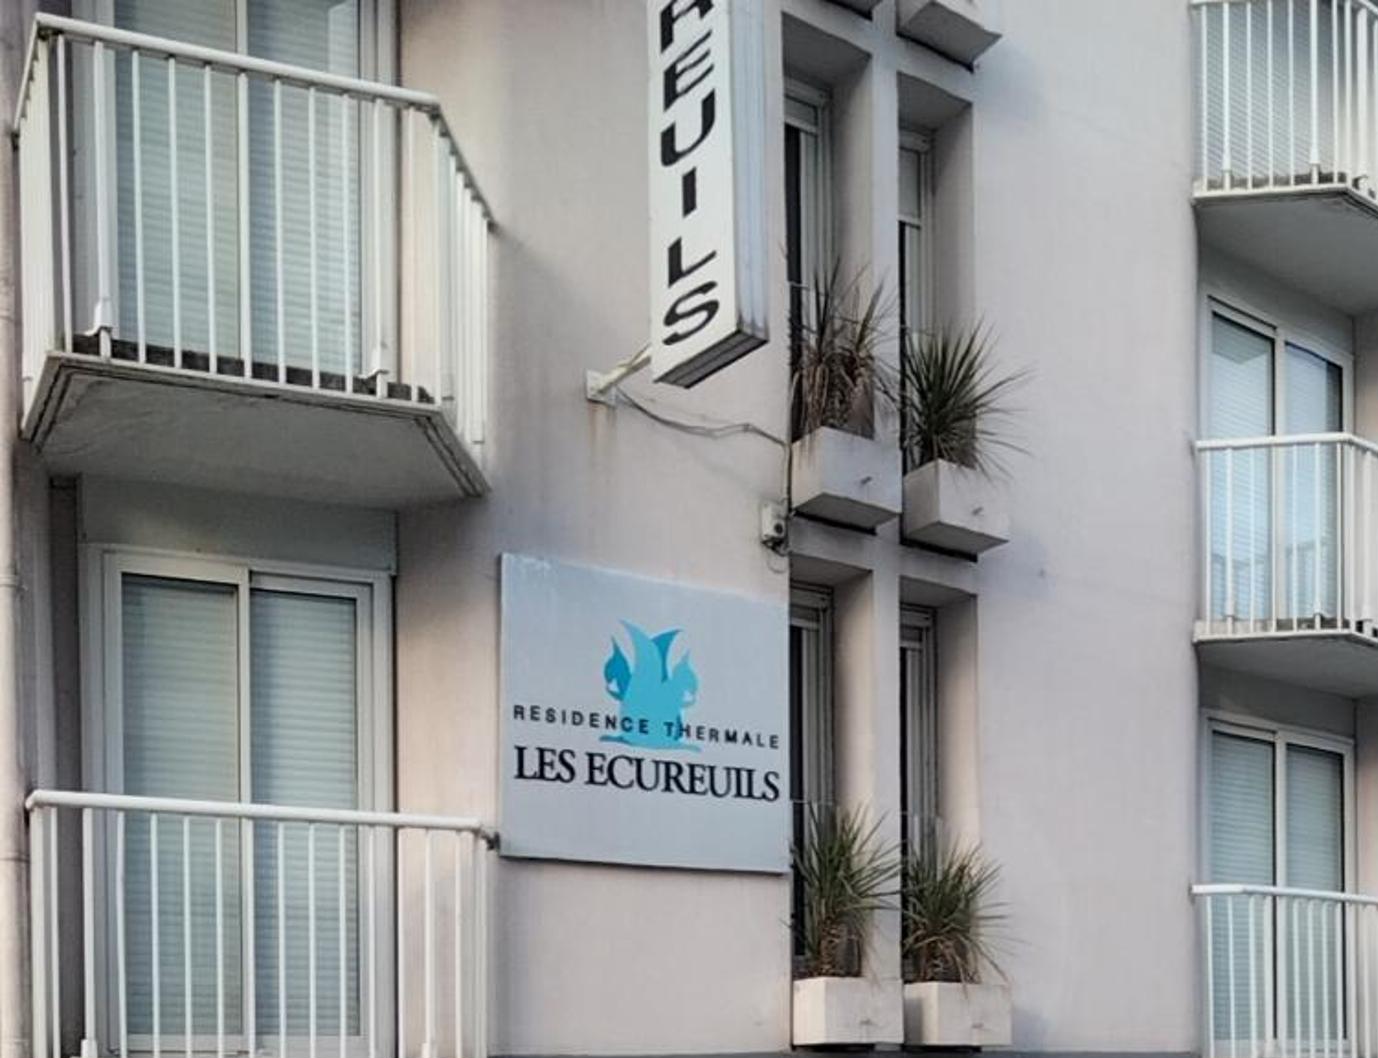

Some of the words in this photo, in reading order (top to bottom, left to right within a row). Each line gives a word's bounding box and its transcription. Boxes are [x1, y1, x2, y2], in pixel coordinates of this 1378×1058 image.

[513, 703, 649, 734] RESIDENCE
[663, 720, 780, 749] THERMALE
[513, 745, 576, 783] LES
[584, 750, 781, 802] ECUREUILS
